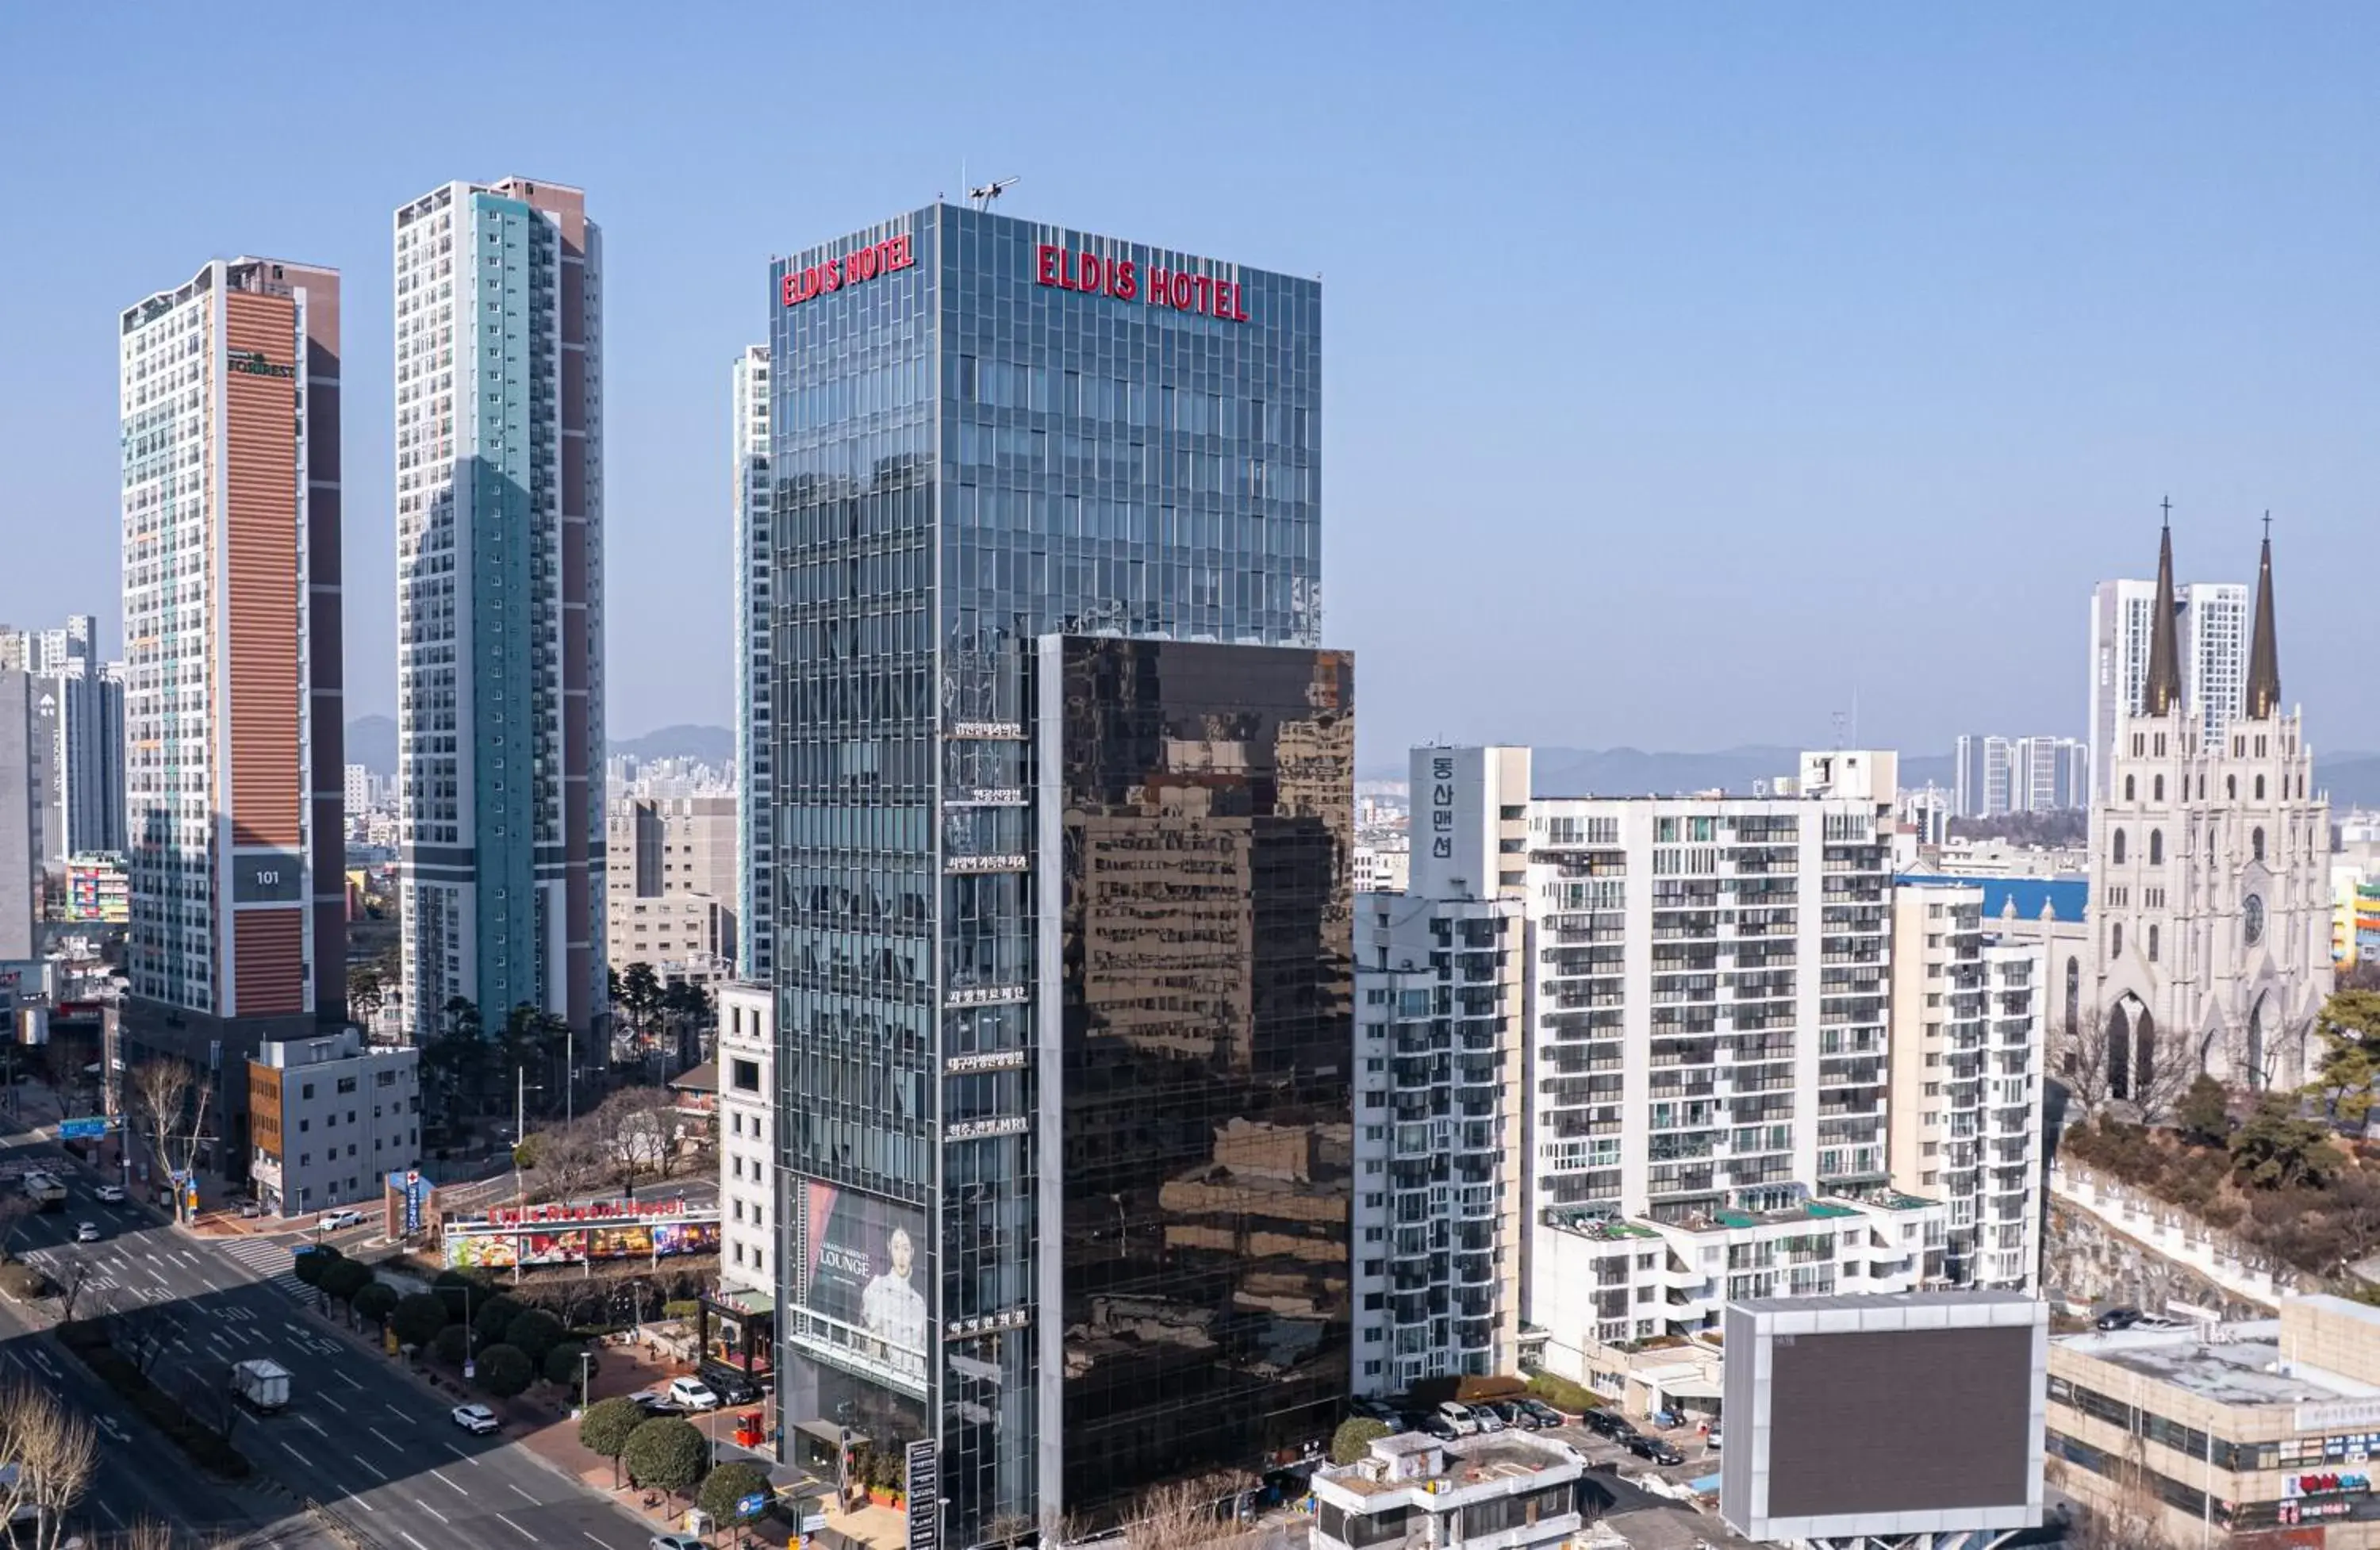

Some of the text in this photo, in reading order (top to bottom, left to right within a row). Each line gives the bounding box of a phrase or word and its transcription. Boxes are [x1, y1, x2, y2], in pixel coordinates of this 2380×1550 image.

[782, 234, 915, 306] ELDIS HOTEL
[1037, 245, 1250, 322] ELDIS HOTEL
[1433, 758, 1454, 858] 동산맨션
[256, 871, 278, 884] 101
[820, 1249, 870, 1278] LOUNGE
